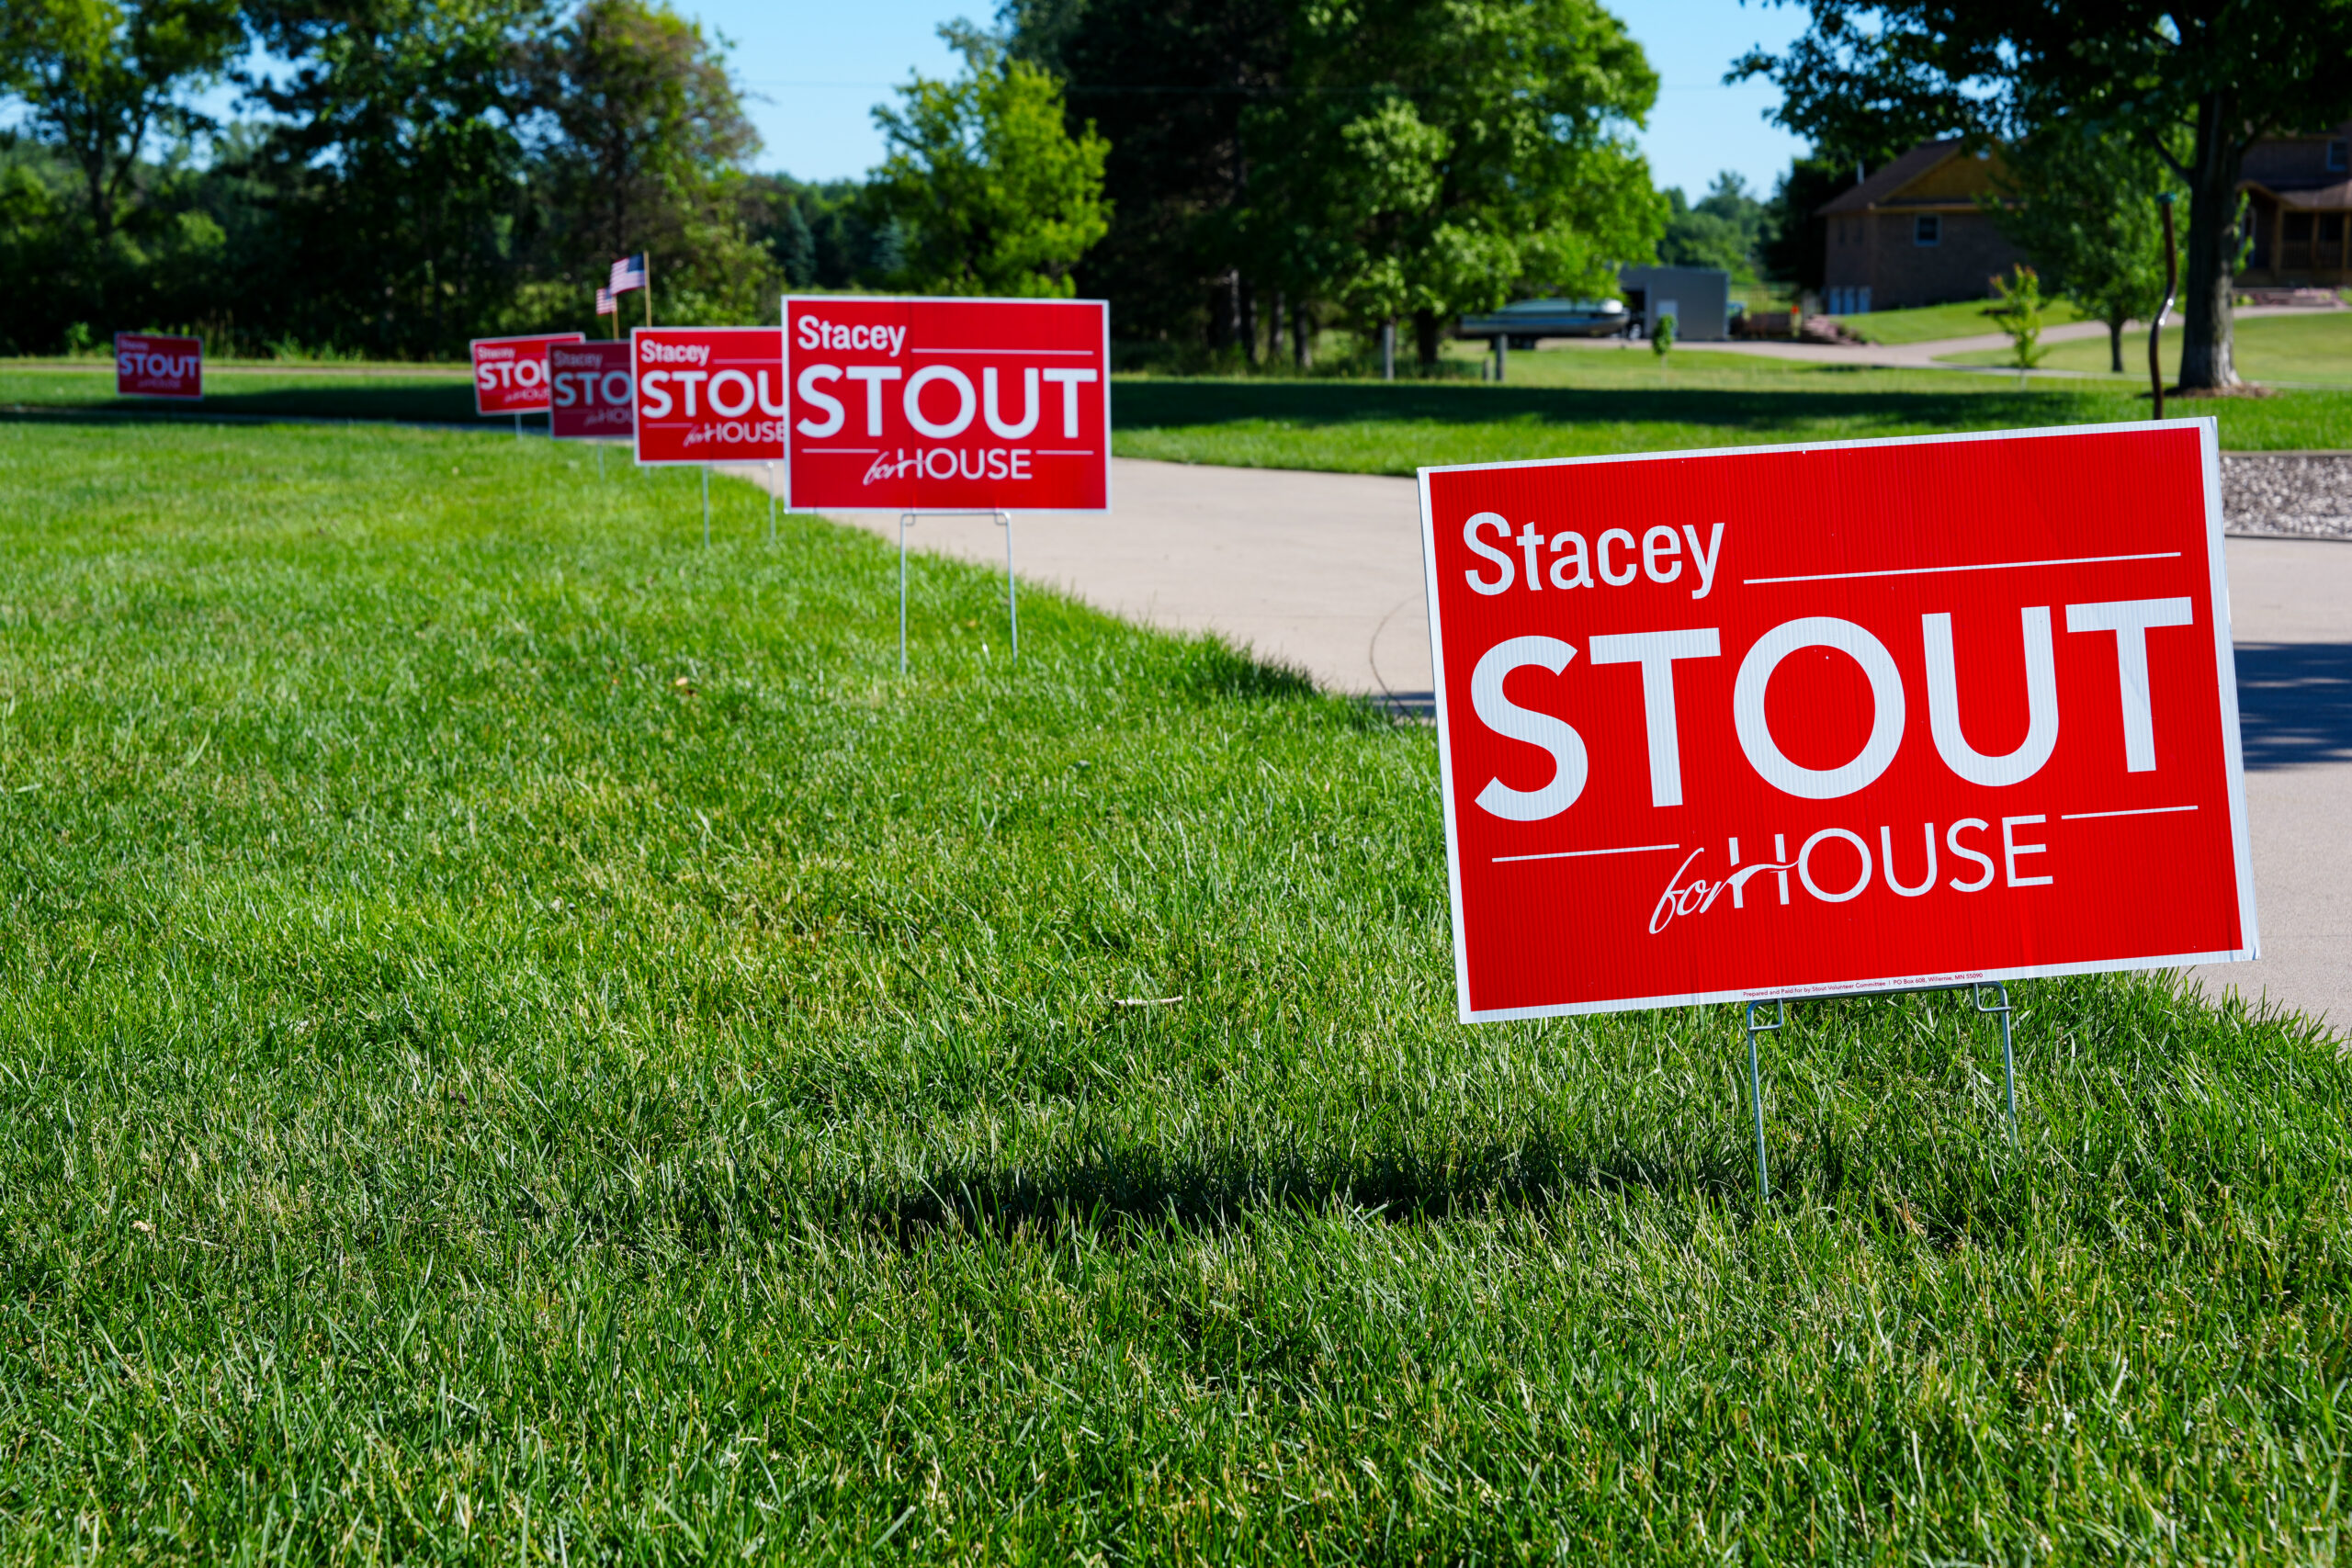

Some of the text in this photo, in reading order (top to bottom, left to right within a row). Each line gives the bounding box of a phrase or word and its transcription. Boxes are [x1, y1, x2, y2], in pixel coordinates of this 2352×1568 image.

[640, 339, 710, 367] Stacey
[797, 314, 907, 357] Stacey
[119, 352, 197, 378] STOUT
[479, 358, 551, 390] STO
[554, 371, 633, 407] STO
[640, 369, 784, 418] STOU
[796, 364, 1098, 439] STOUT
[863, 447, 1033, 485] for HOUSE
[1463, 512, 1725, 599] Stacey
[1471, 596, 2194, 822] STOUT
[1649, 814, 2054, 934] for HOUSE
[1743, 988, 1769, 998] Prepared
